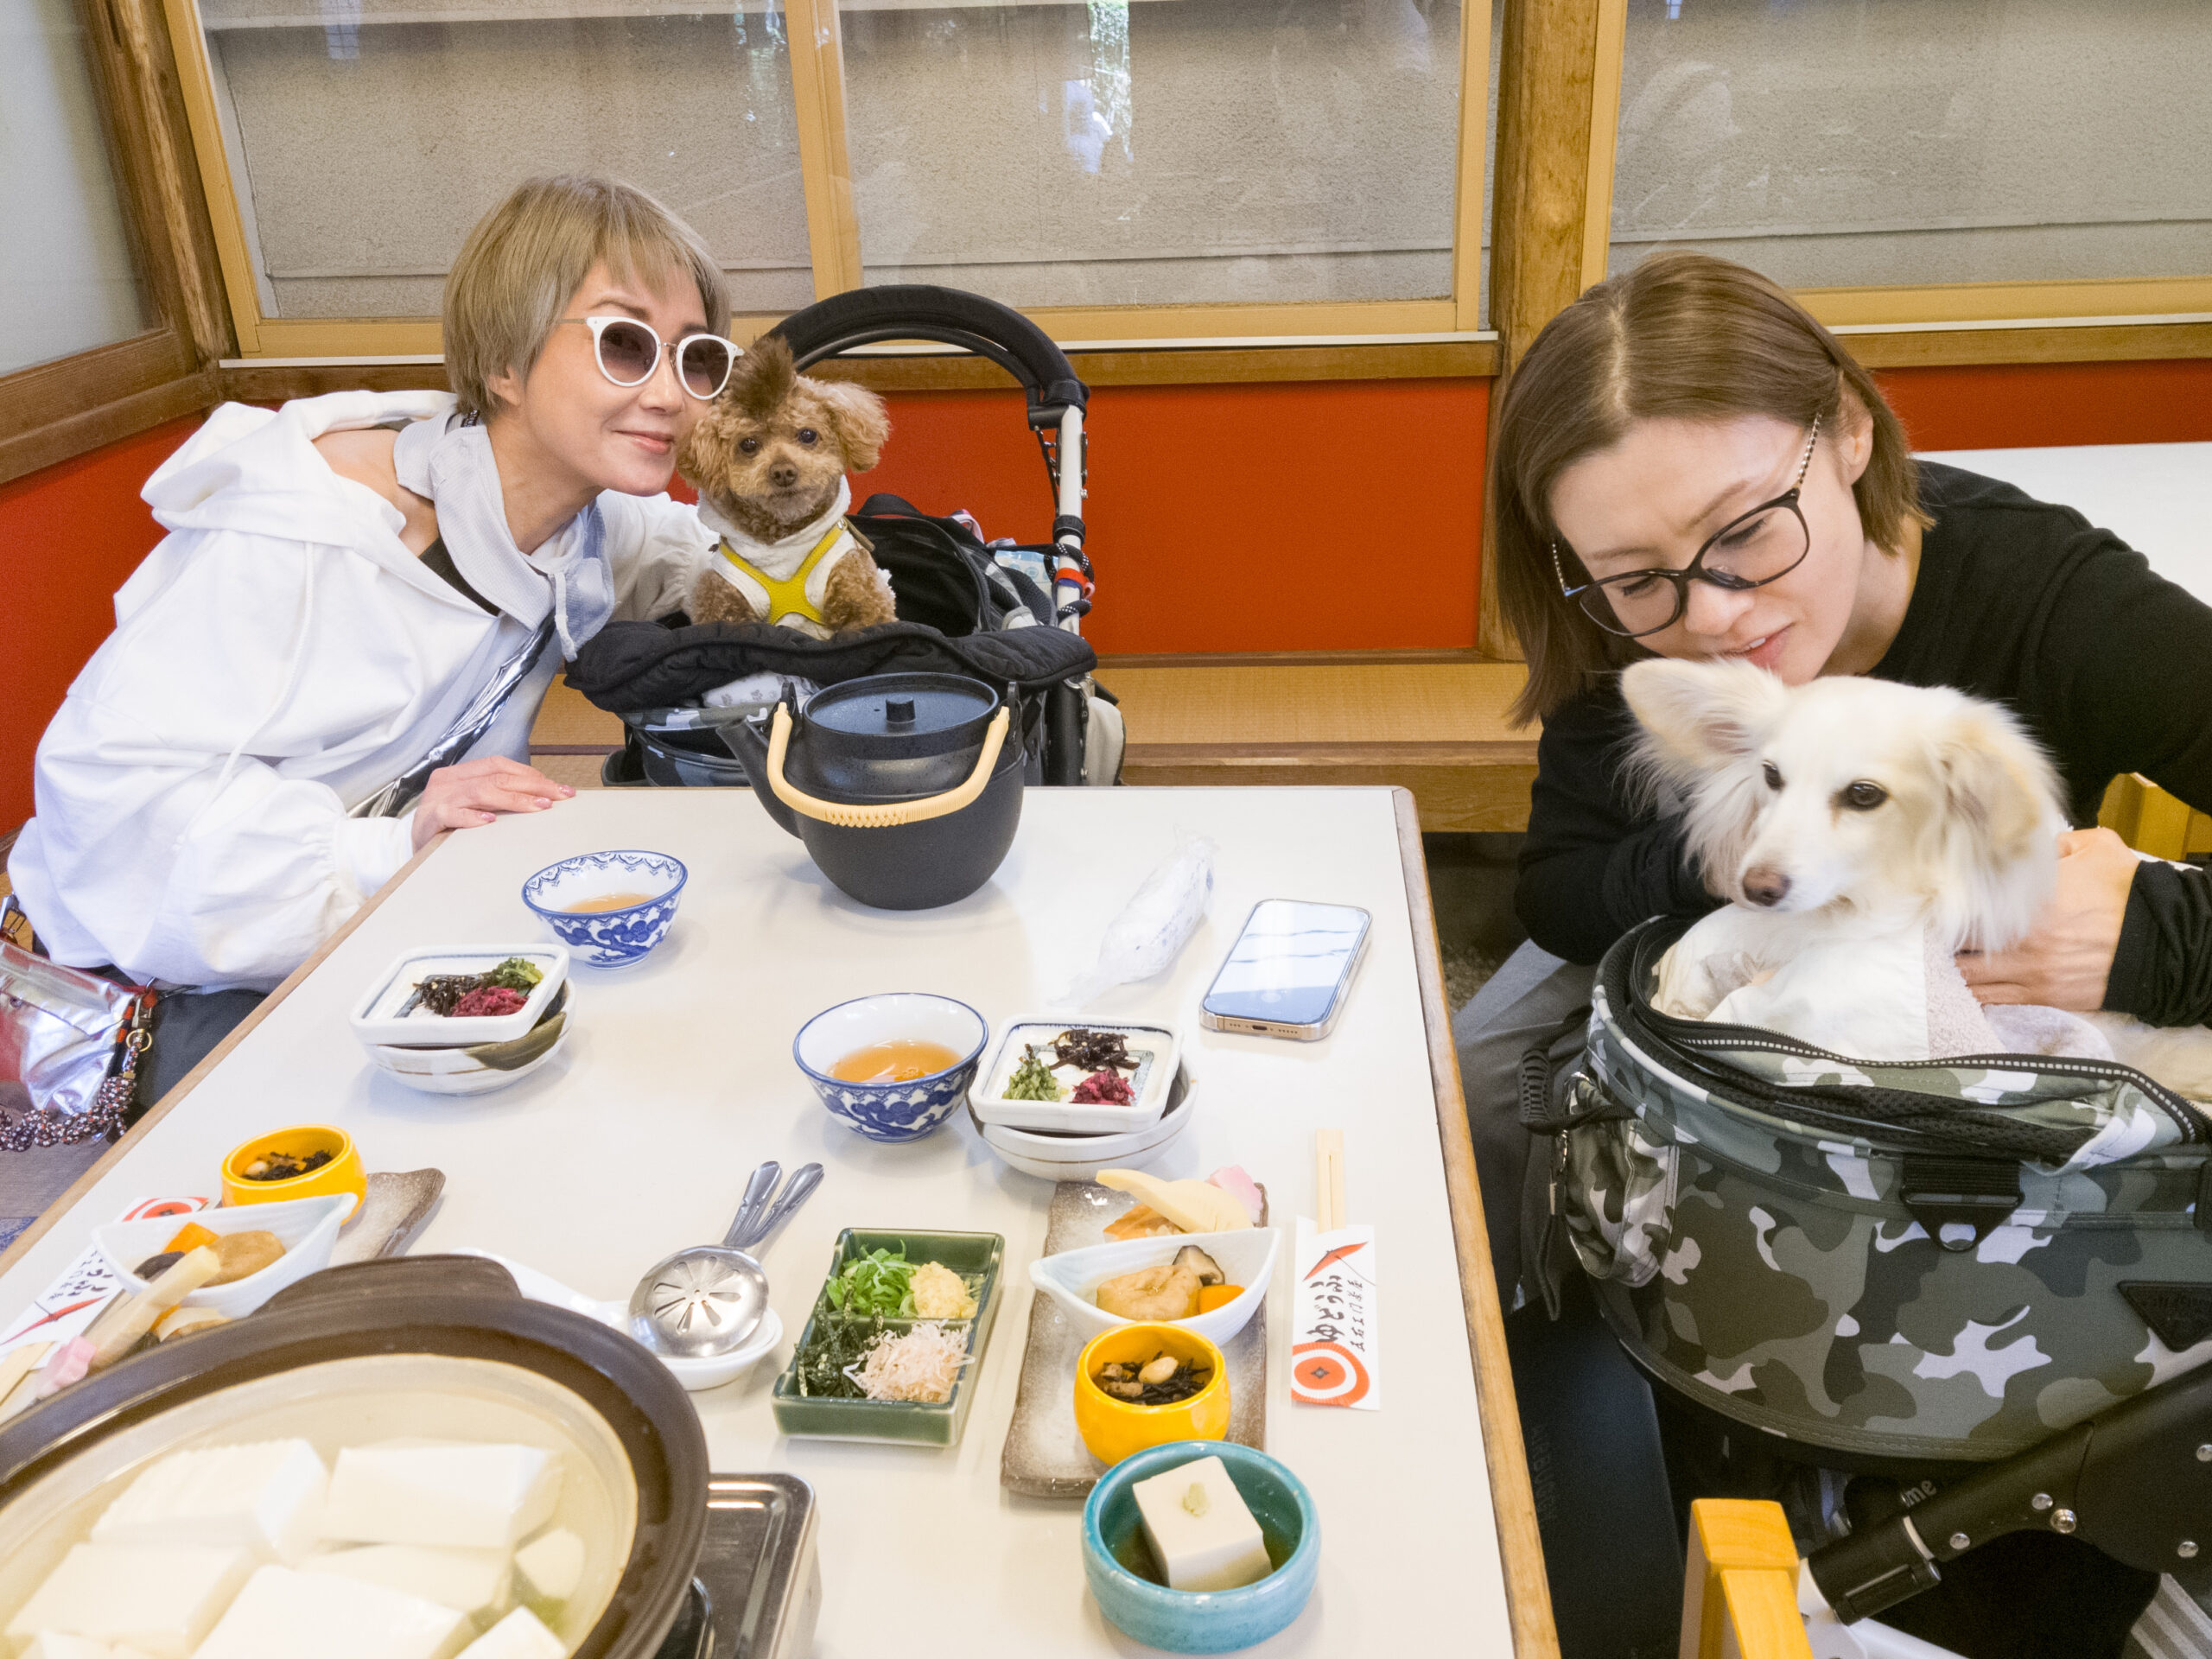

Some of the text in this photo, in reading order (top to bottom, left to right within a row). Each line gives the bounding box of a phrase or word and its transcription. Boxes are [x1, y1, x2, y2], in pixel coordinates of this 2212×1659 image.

[1306, 1275, 1344, 1343] ゆどうふ
[1905, 1480, 1937, 1508] me
